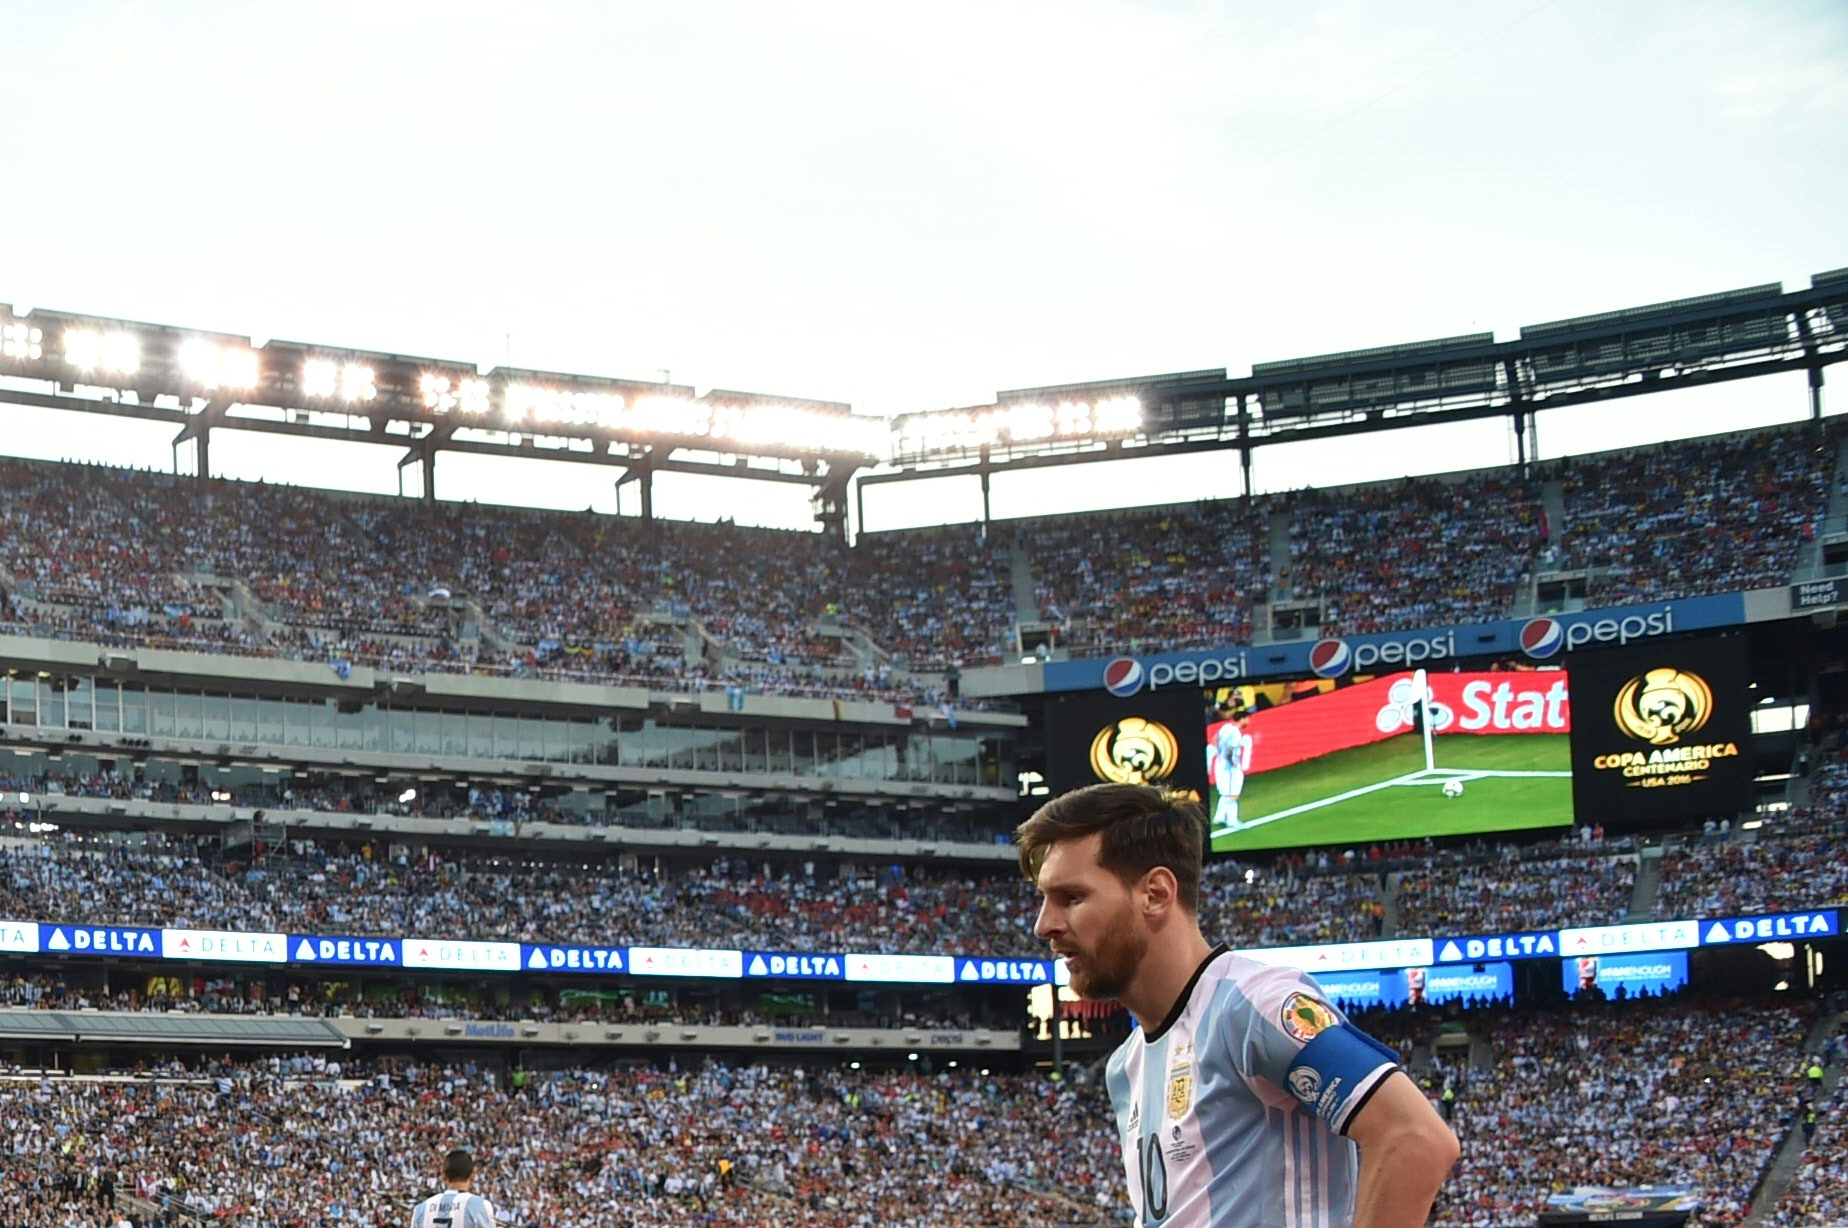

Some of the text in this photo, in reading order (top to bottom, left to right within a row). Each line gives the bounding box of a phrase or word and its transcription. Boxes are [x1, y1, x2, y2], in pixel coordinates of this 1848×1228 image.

[1800, 582, 1834, 593] Need
[1801, 591, 1839, 605] Help?
[1567, 606, 1674, 651] pepsi
[1355, 631, 1455, 668] pepsi
[1151, 651, 1247, 689] pepsi
[1593, 742, 1739, 770] COPA AMERICA
[1622, 759, 1710, 777] CENTENARIO
[1642, 777, 1666, 788] USA
[1734, 913, 1829, 939] DELTA
[73, 927, 155, 952] DELTA
[201, 935, 274, 955] DELTA
[318, 939, 395, 961] DELTA
[1467, 935, 1554, 958] DELTA
[551, 948, 623, 969] DELTA
[770, 955, 840, 975] DELTA
[981, 961, 1046, 981] DELTA
[1137, 1133, 1167, 1224] 10
